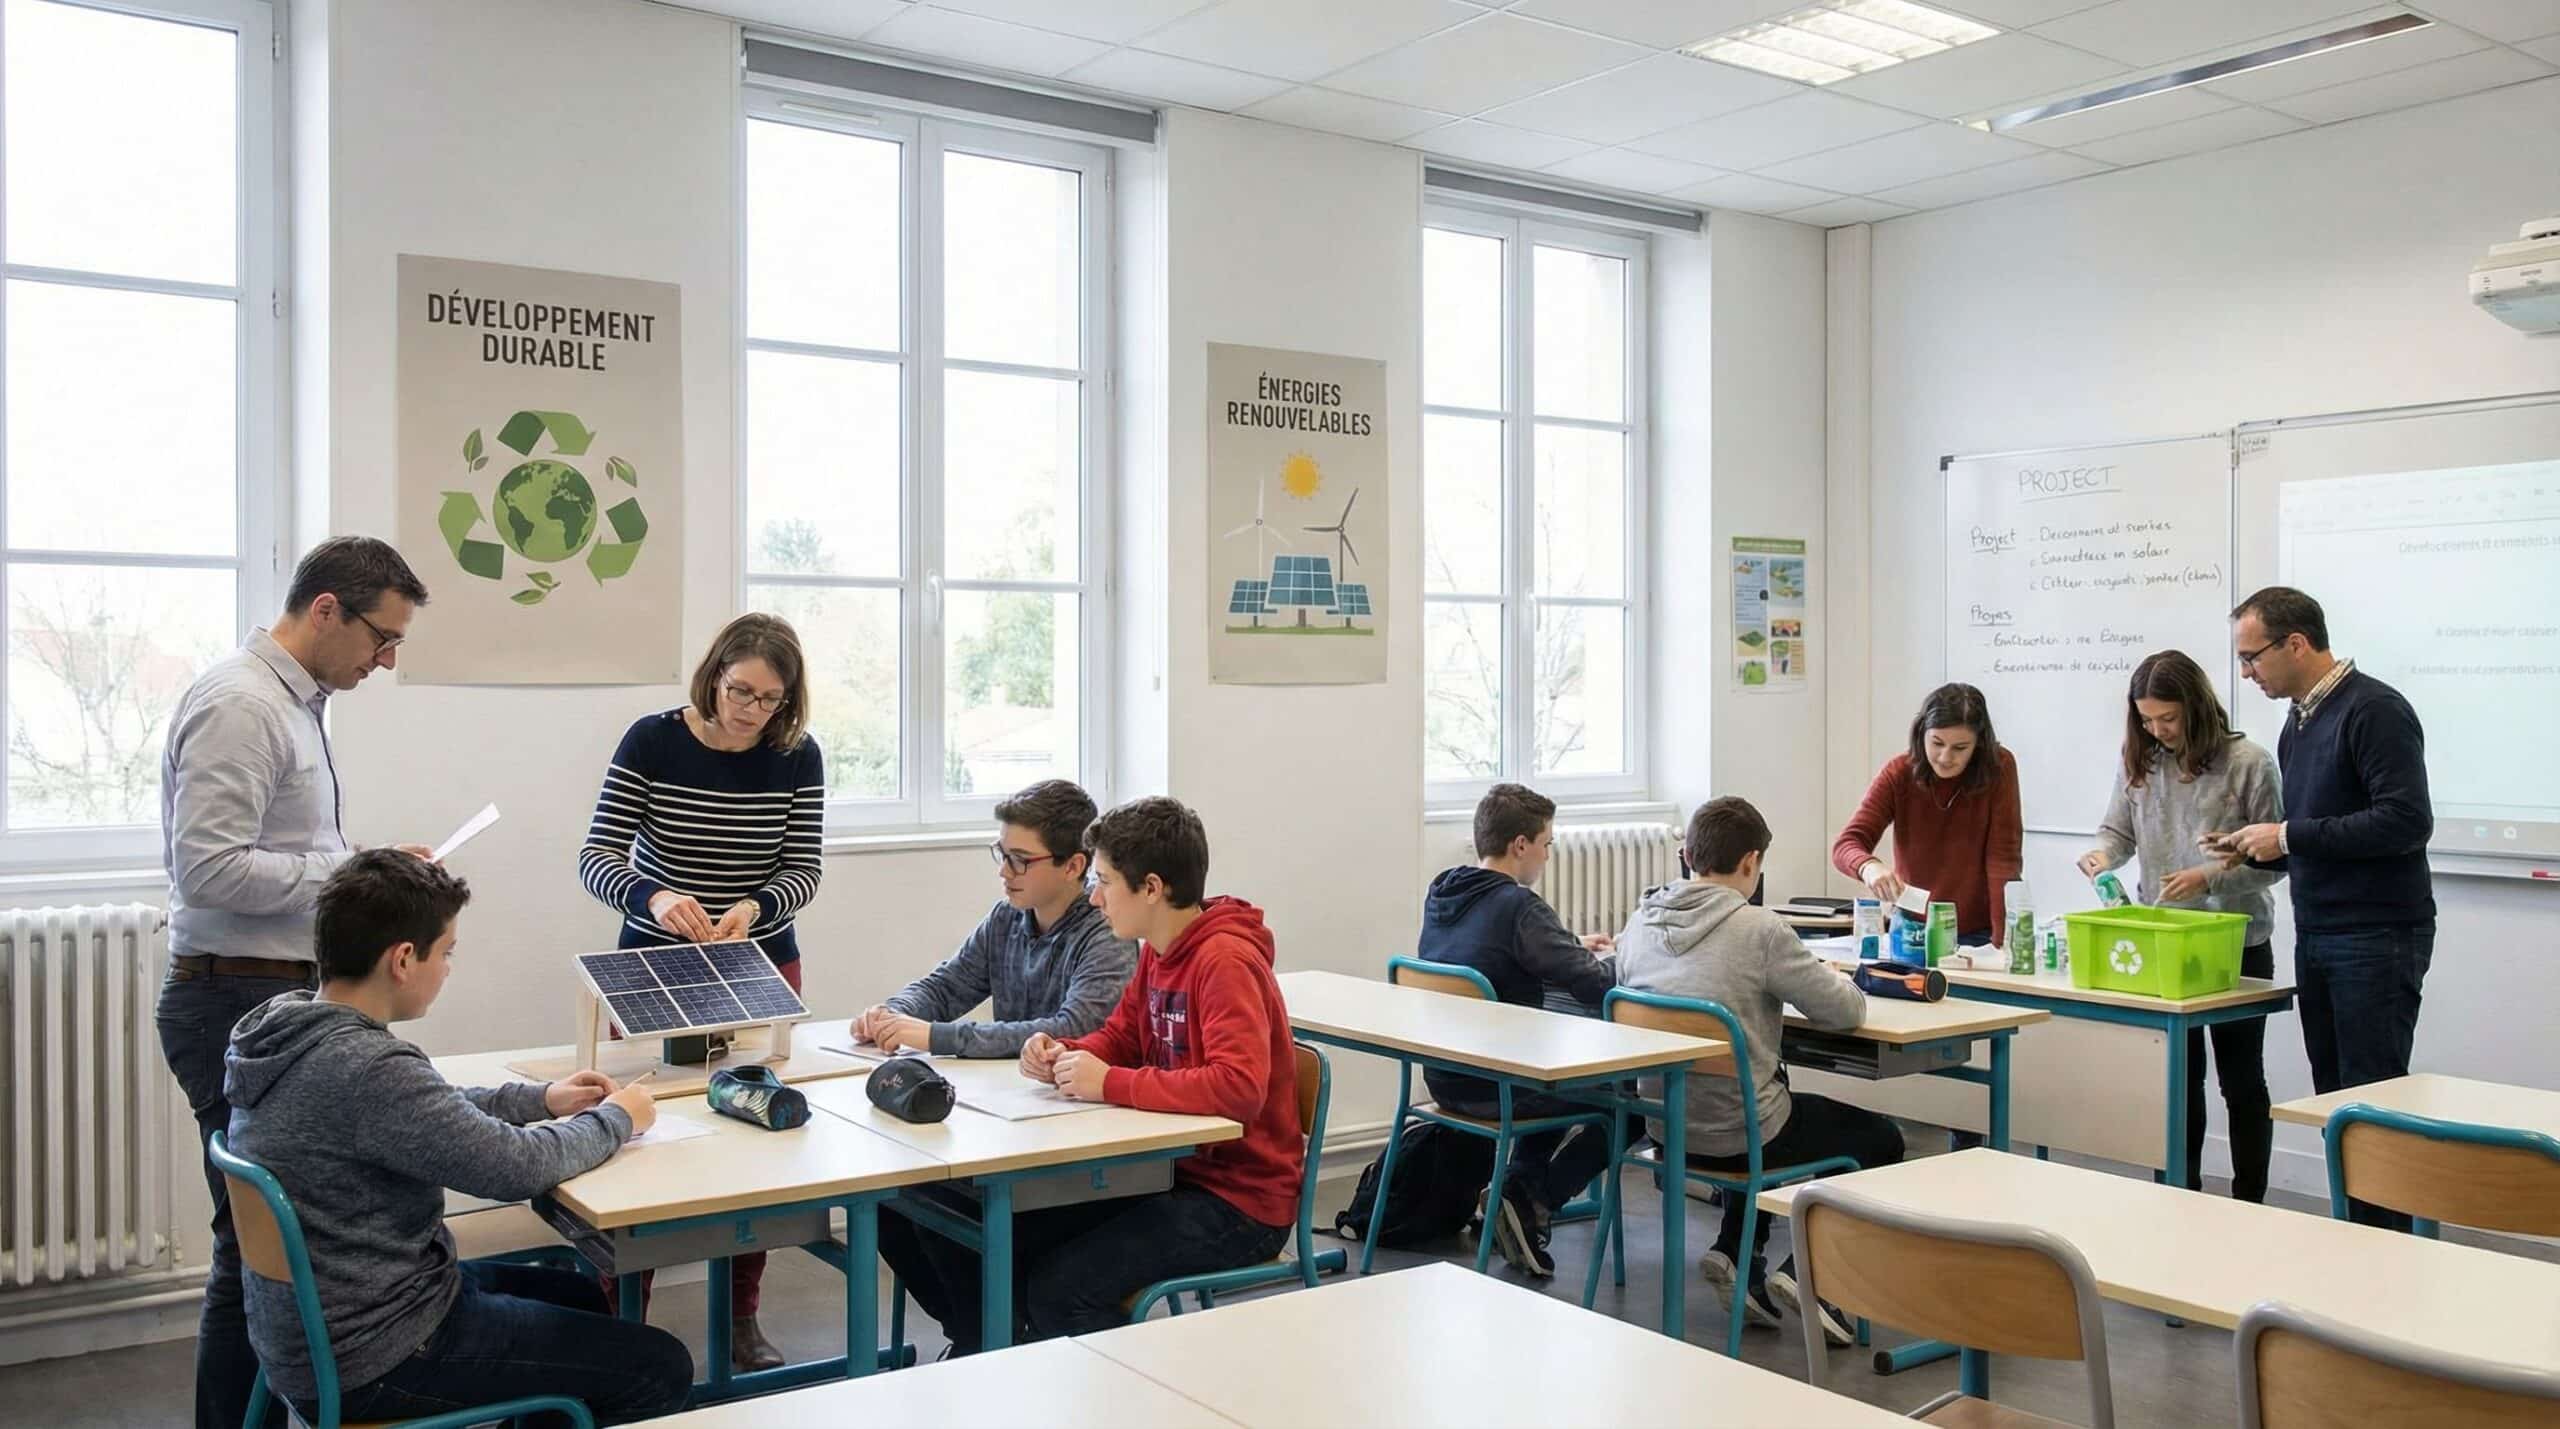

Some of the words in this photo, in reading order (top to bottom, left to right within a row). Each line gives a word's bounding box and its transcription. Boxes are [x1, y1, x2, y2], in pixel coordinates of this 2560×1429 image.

[428, 289, 655, 343] DÉVELOPPEMENT
[482, 333, 606, 371] DURABLE
[1258, 371, 1341, 406] ÉNERGIES
[1227, 401, 1371, 436] RENOUVELABLES
[2018, 465, 2117, 495] PROJECT
[1971, 526, 2016, 554] Project
